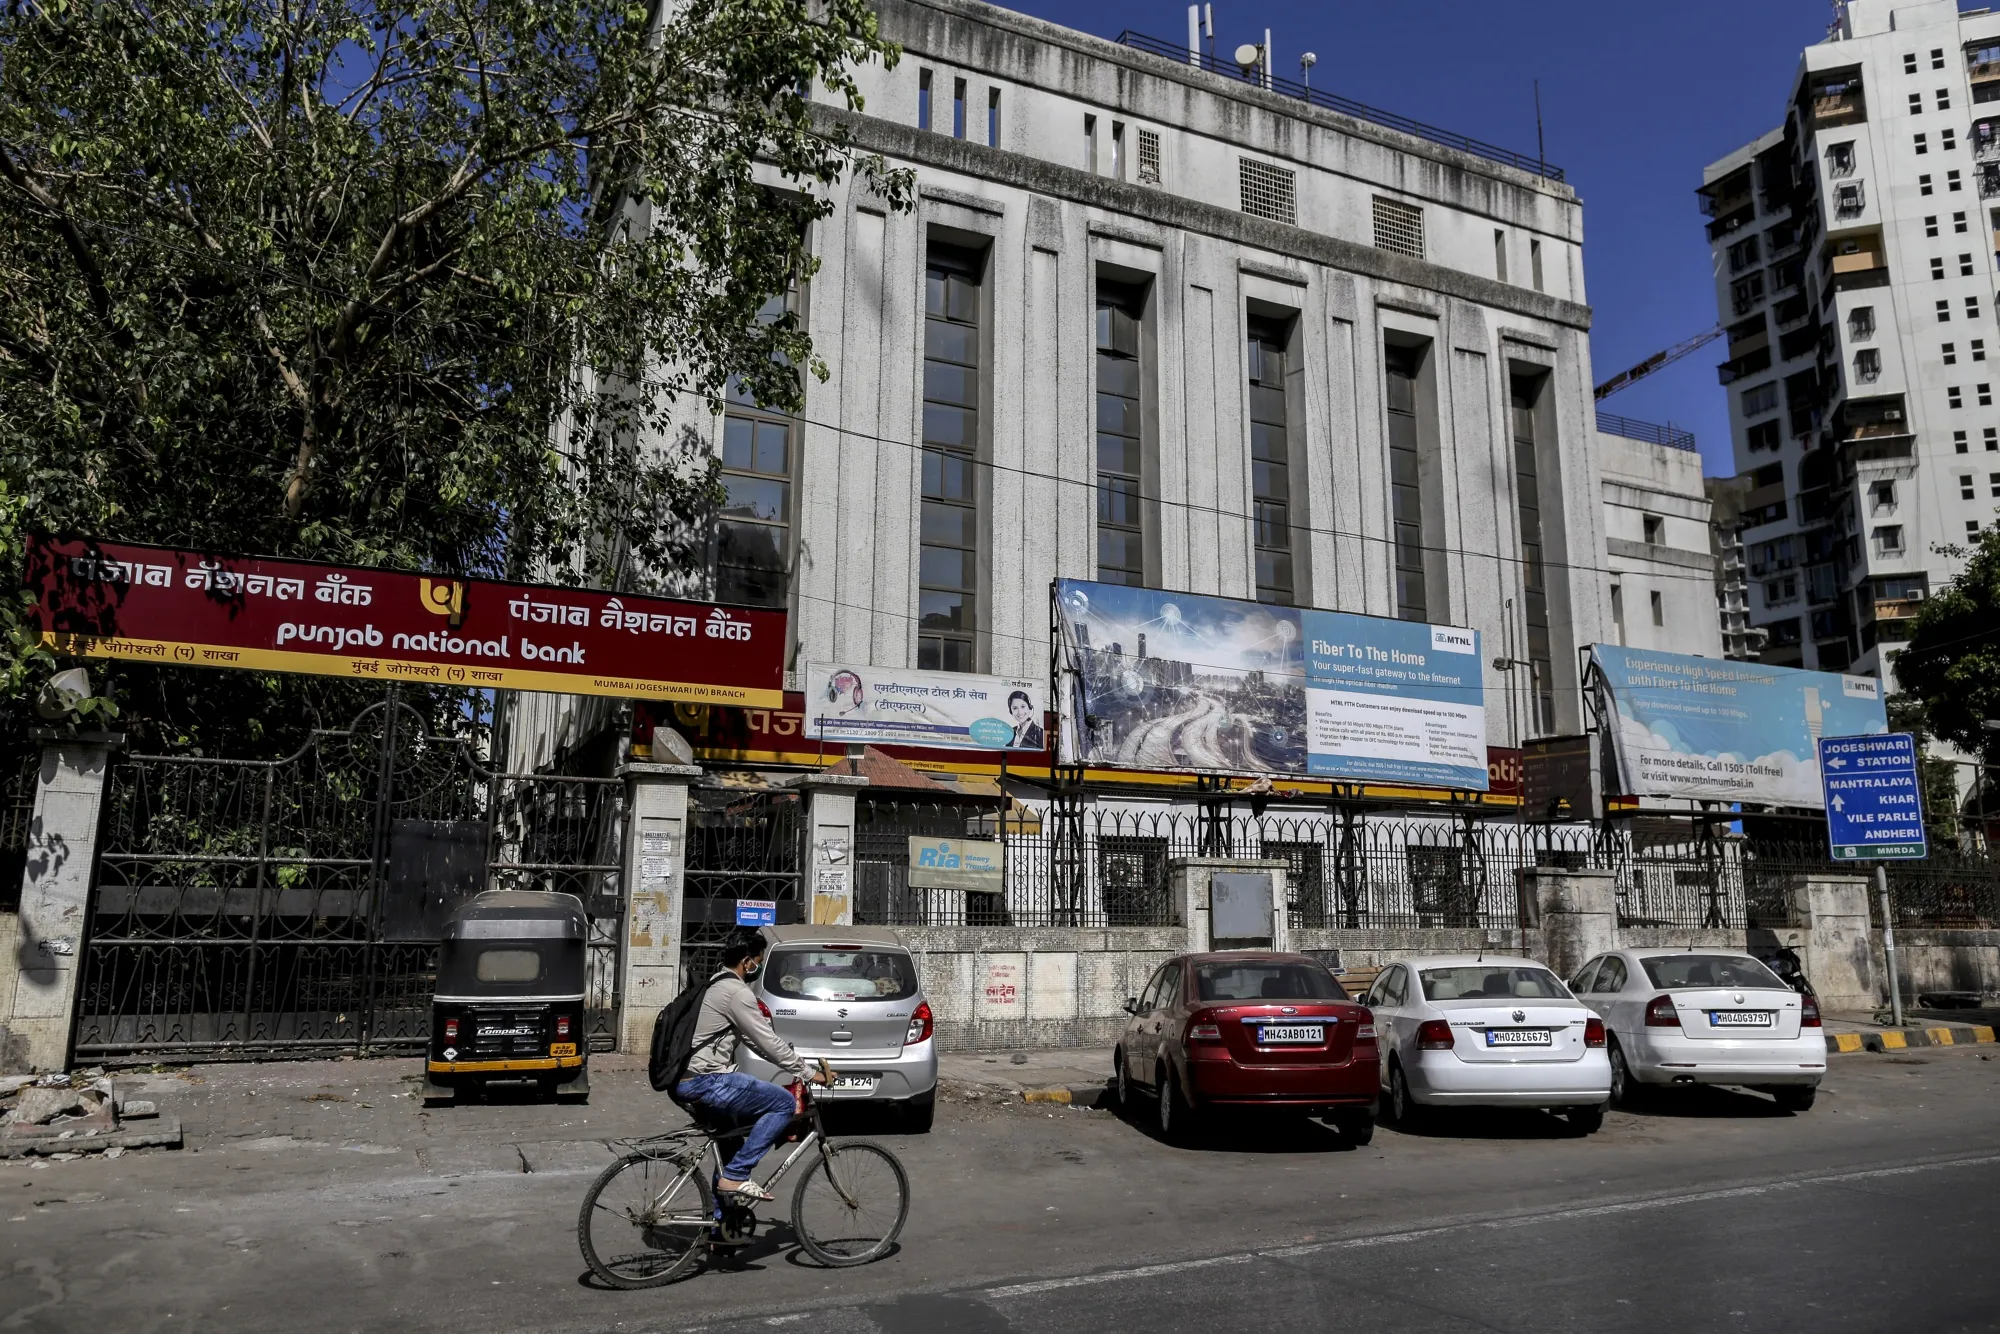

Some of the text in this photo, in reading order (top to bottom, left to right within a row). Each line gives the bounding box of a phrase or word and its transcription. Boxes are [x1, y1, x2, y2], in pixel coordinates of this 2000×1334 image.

[71, 550, 172, 587] पंजाब
[508, 593, 752, 641] पंजाब नैशनल बैंक
[276, 622, 586, 664] punjab national bank
[1447, 635, 1472, 646] MTNL
[103, 639, 167, 656] जोगेश्वरी
[173, 645, 196, 660] (प)
[202, 649, 241, 662] शाखा
[1311, 639, 1426, 666] Fiber To The Home
[351, 659, 504, 682] मुंबई जोगेश्वरी (प) शाखा
[1312, 660, 1462, 685] Your super-fast gateway to the Internet
[1625, 656, 1681, 676] Experience
[1682, 664, 1704, 680] High
[1705, 667, 1734, 682] Speed
[593, 679, 746, 699] MUMBAI JOGESHWARI (W) BRANCH
[874, 682, 988, 701] एमटीएनएल टोल फ्री सेवा
[1627, 675, 1738, 697] with Fibre To the Home
[1854, 682, 1876, 692] MTNL
[874, 698, 927, 714] (टीएफएस)
[1355, 702, 1380, 710] Customers
[1651, 701, 1682, 711] download
[1682, 704, 1701, 714] speed
[1701, 707, 1710, 715] up
[1710, 707, 1718, 715] to
[1824, 741, 1909, 754] JOGESHWARI
[1640, 754, 1784, 777] For more details, Call 1505 (Toll free)
[1857, 755, 1911, 767] STATION
[1641, 771, 1754, 788] or visit www.mtnlmumbai.in
[1829, 777, 1913, 789] MANTRALAYA
[1879, 794, 1915, 804] KHAR
[1846, 812, 1918, 823] VILE PARLE
[1864, 829, 1920, 839] ANDHERI
[918, 842, 961, 869] Ria
[1877, 846, 1916, 855] MMRDA
[964, 854, 991, 864] Money
[964, 862, 997, 872] Transfer
[1717, 1013, 1768, 1024] MH04DG9797
[1264, 1028, 1322, 1040] MH43AB0121
[1494, 1032, 1549, 1043] MH02BZ6679
[850, 1077, 872, 1087] 1274
